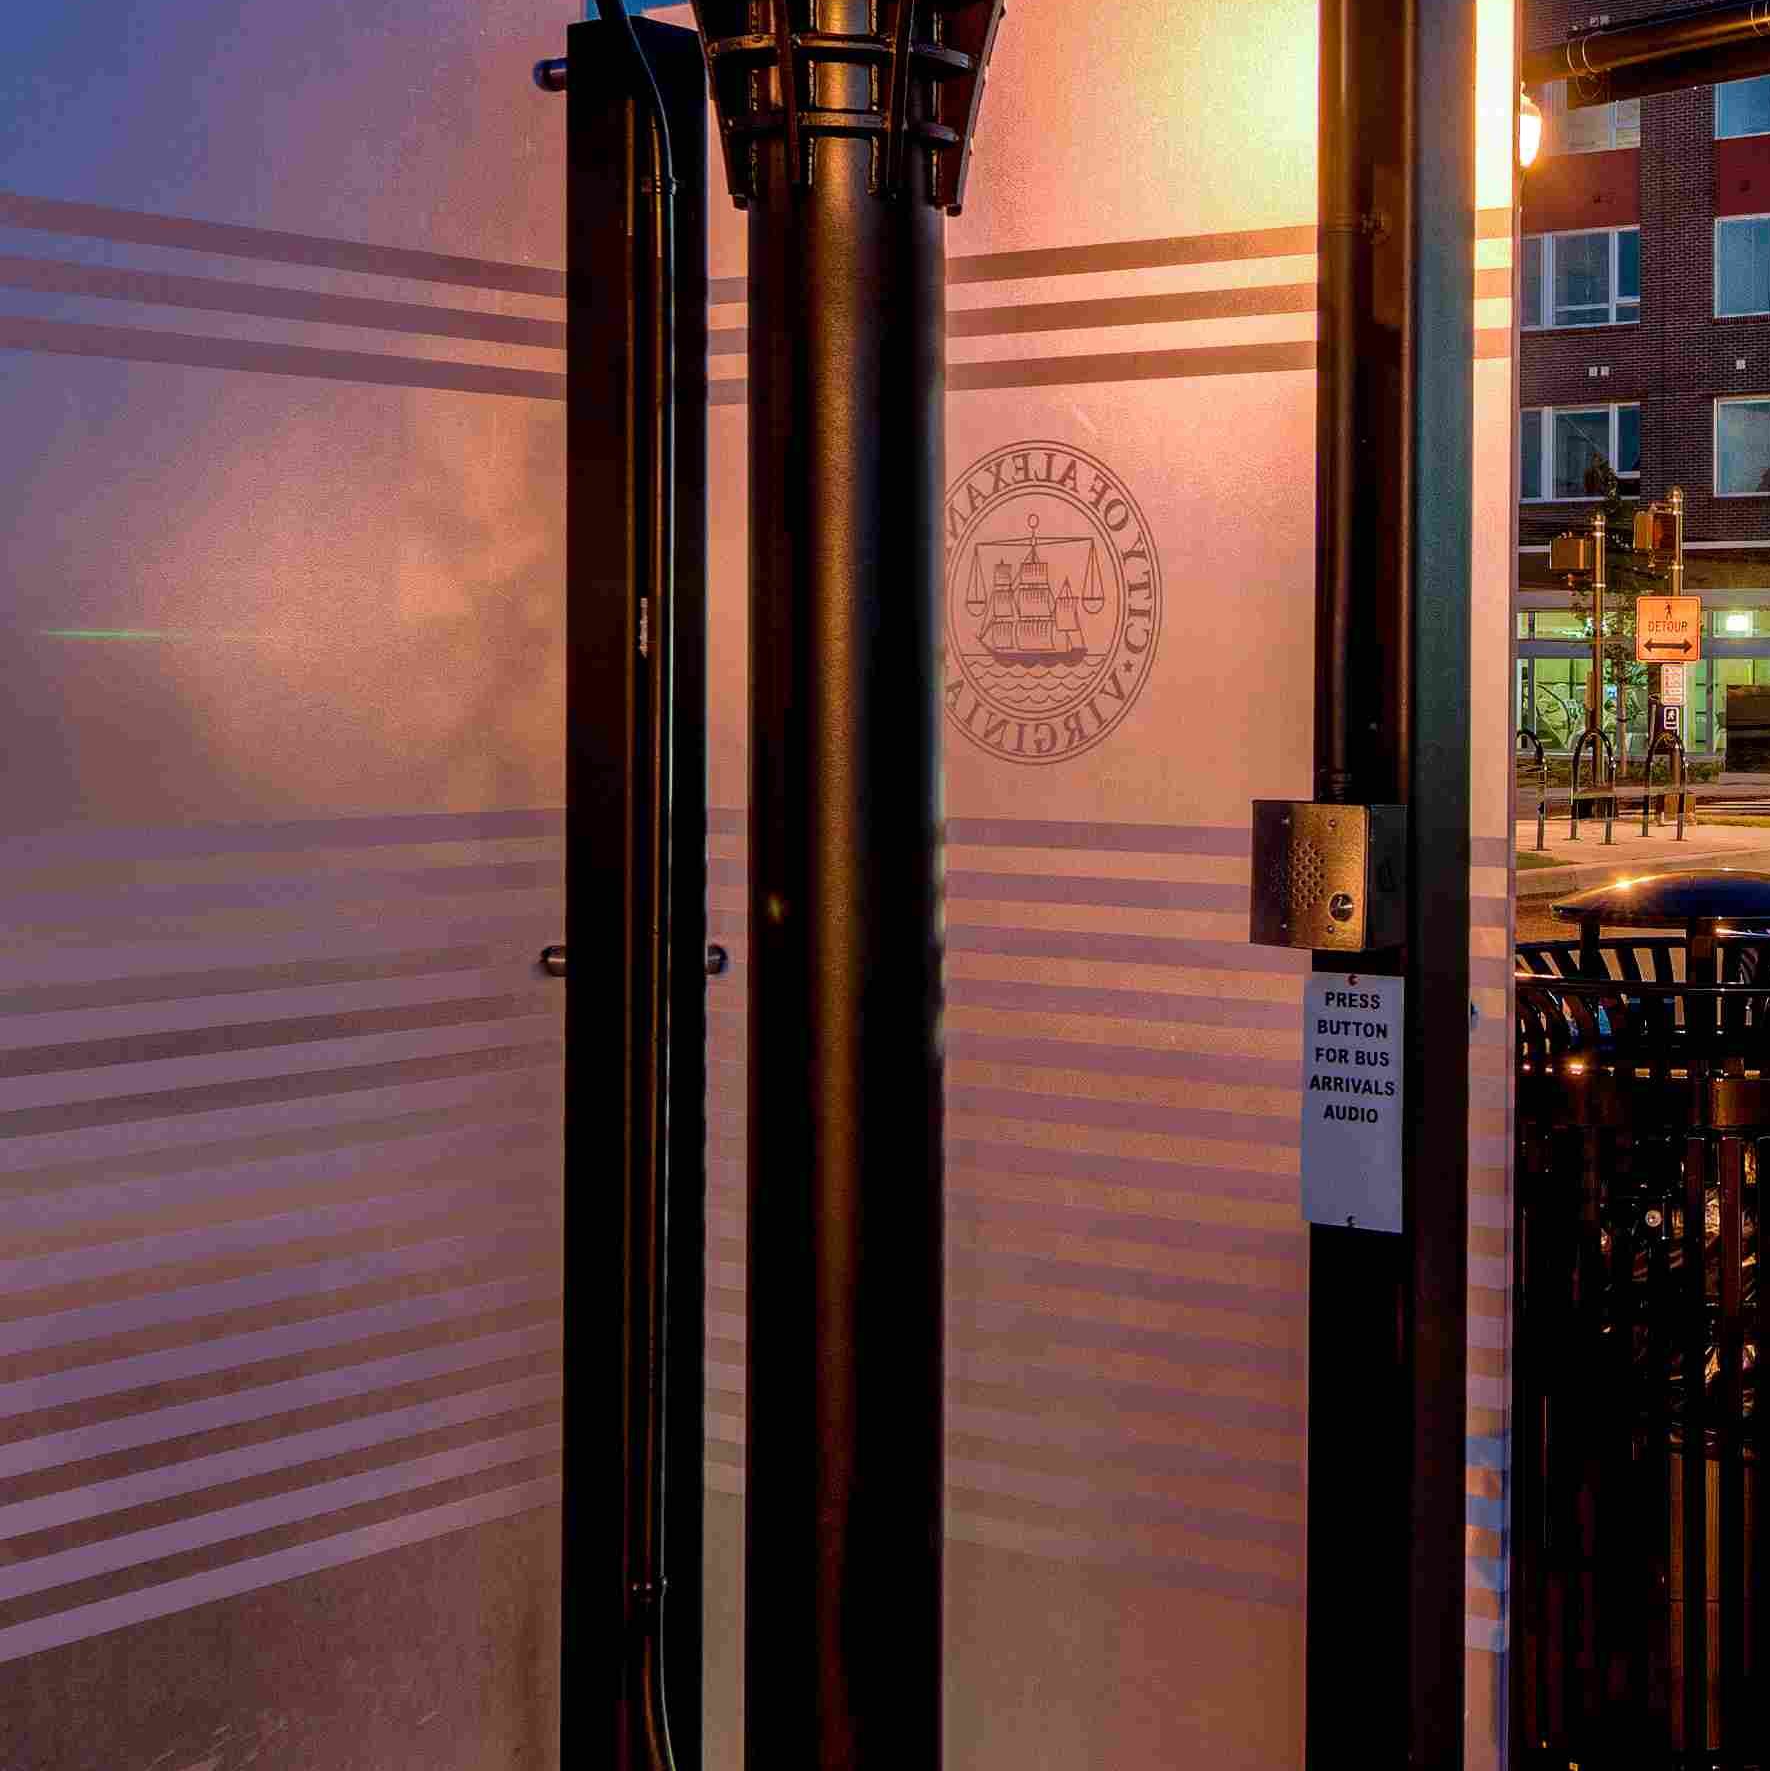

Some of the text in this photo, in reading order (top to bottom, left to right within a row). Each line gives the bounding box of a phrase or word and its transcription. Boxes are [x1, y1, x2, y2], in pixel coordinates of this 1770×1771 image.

[1647, 620, 1688, 633] DETOUR
[1325, 991, 1381, 1010] PRESS
[1317, 1018, 1388, 1039] BUTTON
[1315, 1046, 1389, 1067] FOR BUS
[1309, 1074, 1395, 1096] ARRIVALS
[1323, 1104, 1379, 1124] AUDIO
